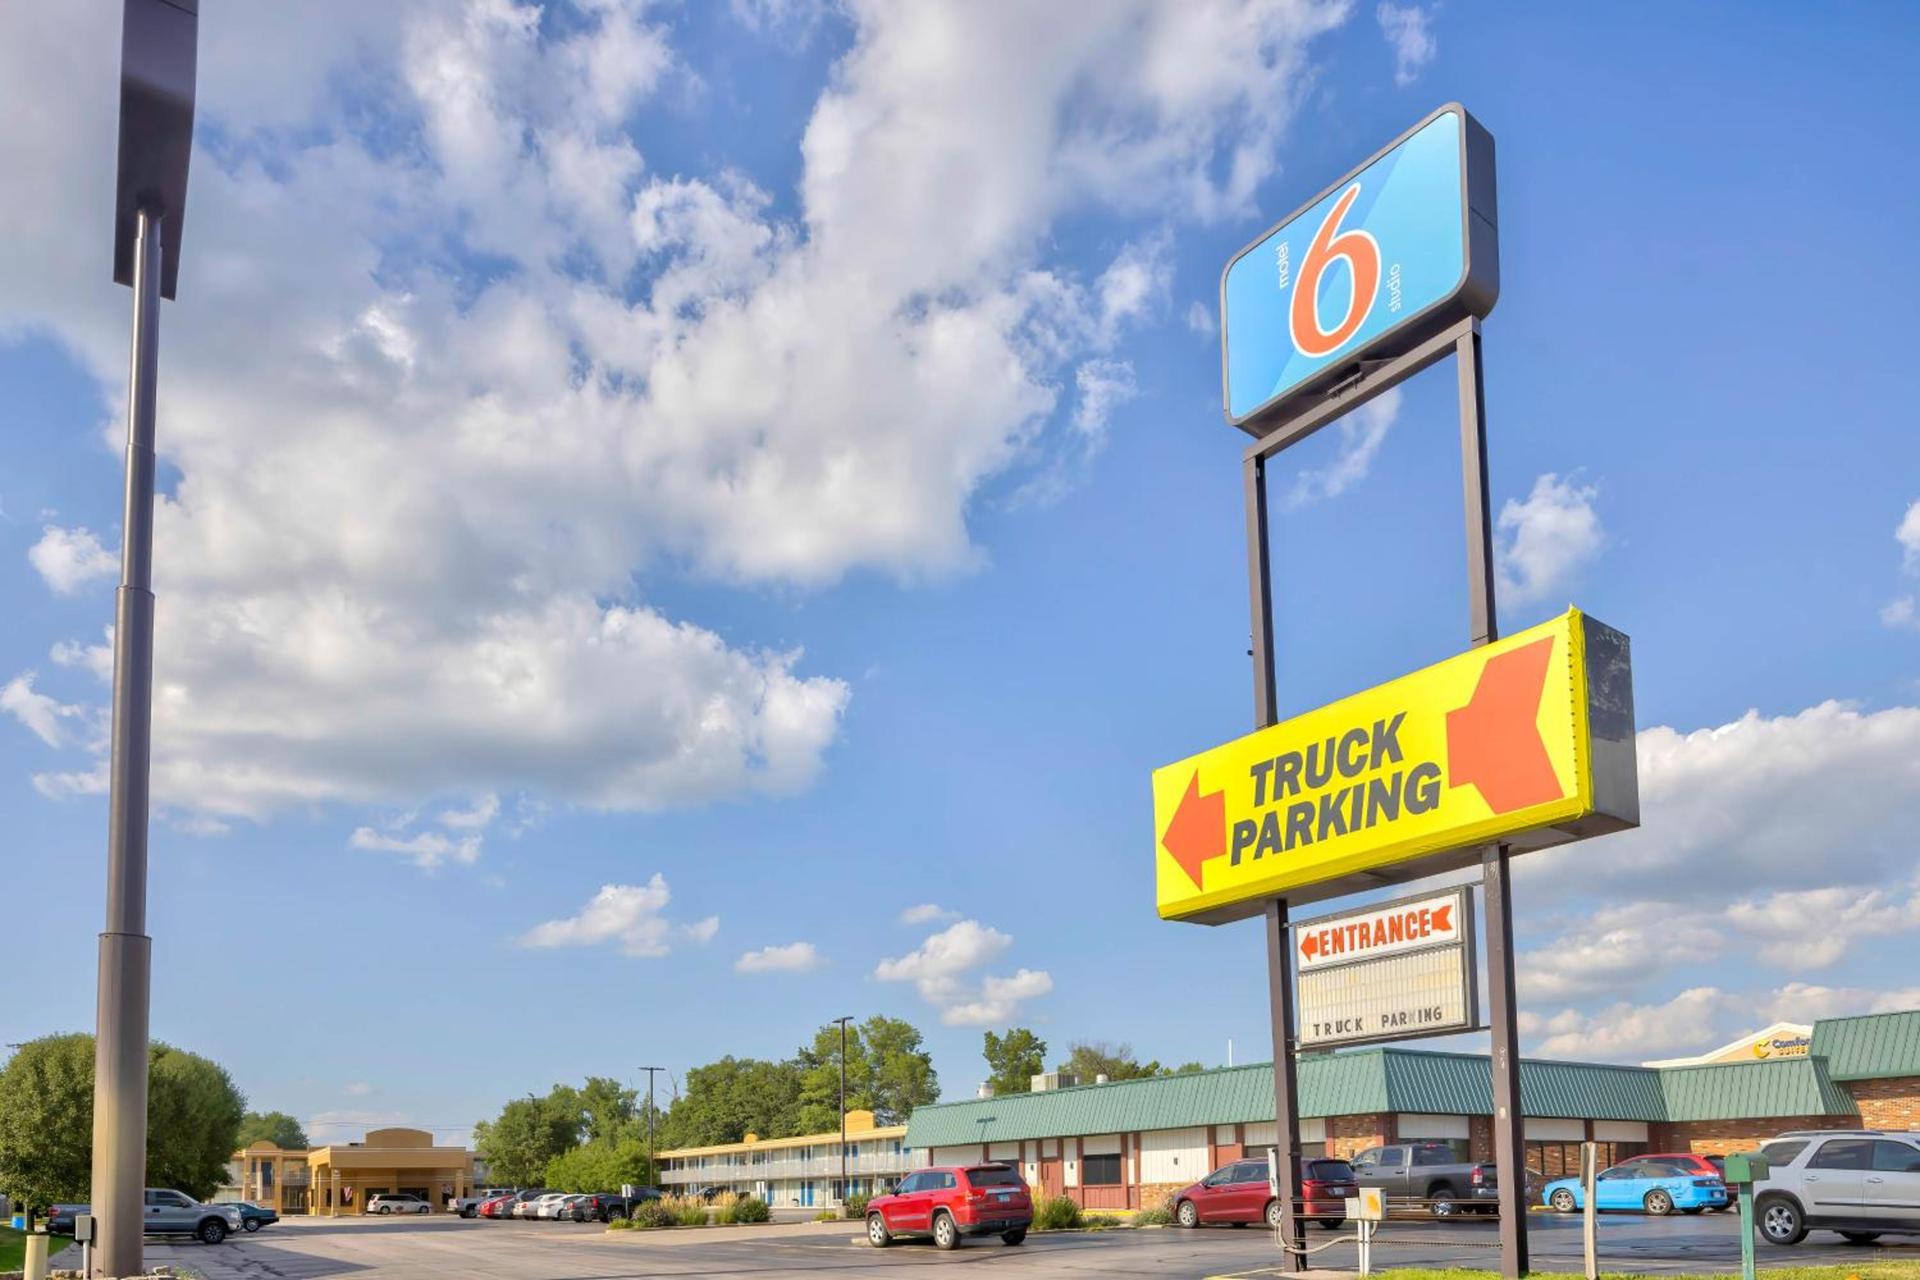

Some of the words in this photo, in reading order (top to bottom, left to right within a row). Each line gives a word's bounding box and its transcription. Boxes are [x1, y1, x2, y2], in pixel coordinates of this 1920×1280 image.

[1275, 241, 1289, 290] motel
[1289, 182, 1382, 358] 6
[1386, 263, 1401, 313] studio
[1249, 711, 1407, 807] TRUCK
[1230, 762, 1441, 866] PARKING
[1319, 908, 1430, 957] ENTRANCE
[1313, 1017, 1363, 1036] TRUCK
[1381, 1006, 1442, 1027] PARKING
[1772, 1036, 1810, 1048] Comfor
